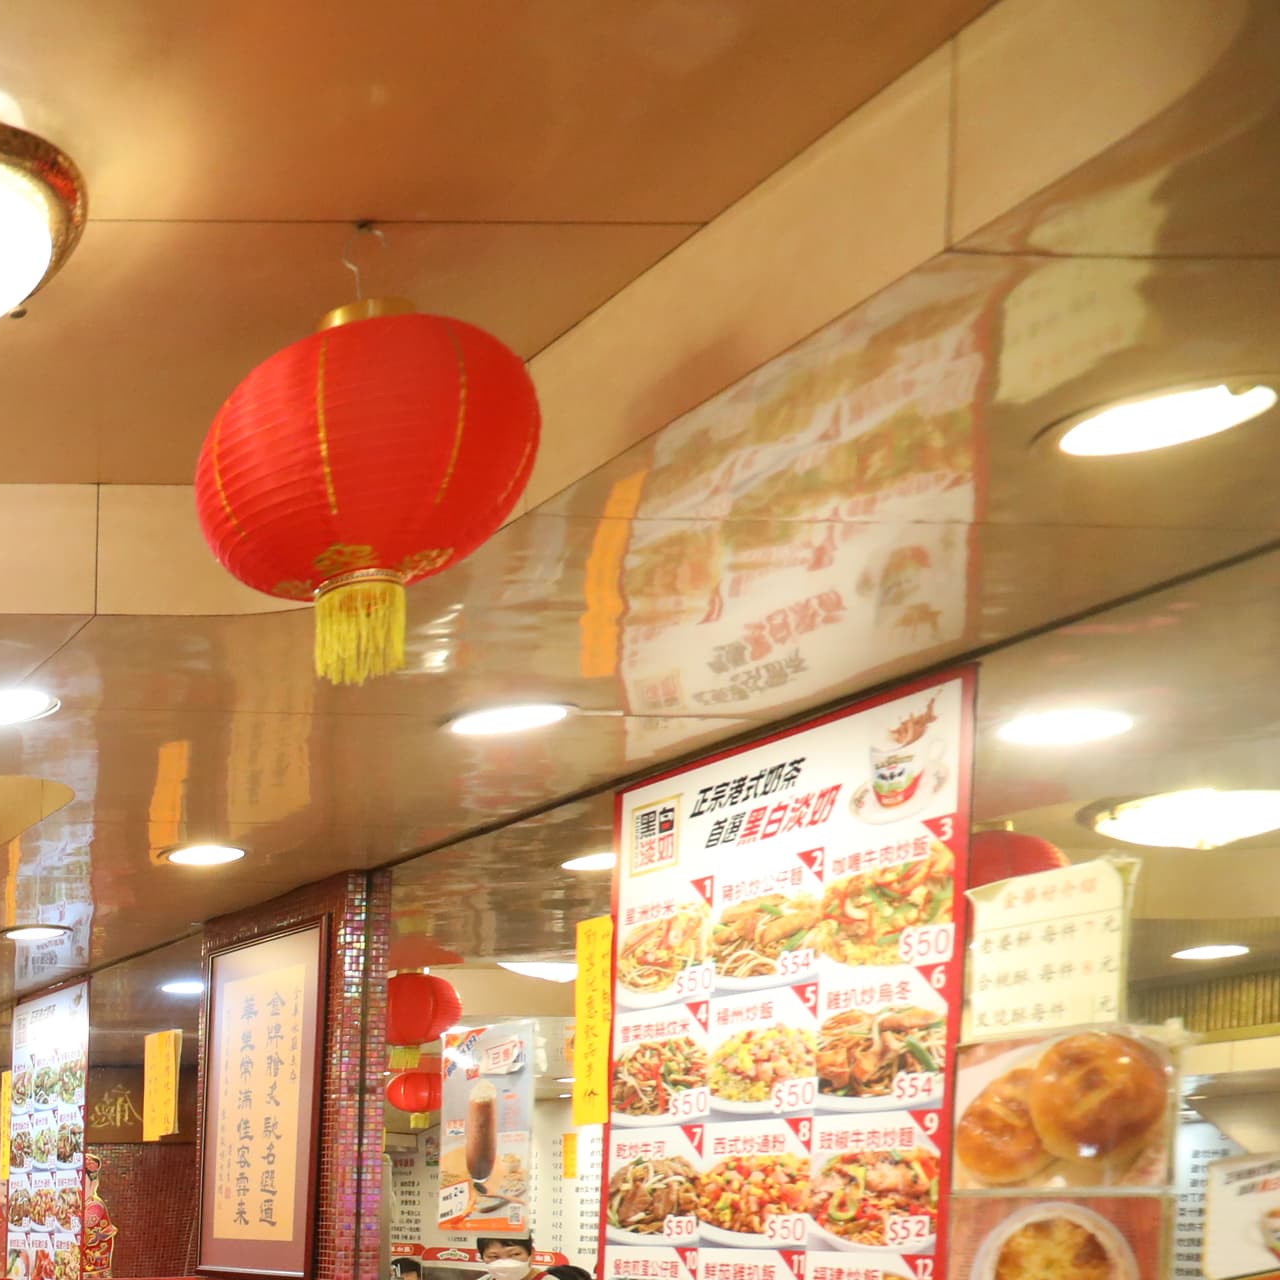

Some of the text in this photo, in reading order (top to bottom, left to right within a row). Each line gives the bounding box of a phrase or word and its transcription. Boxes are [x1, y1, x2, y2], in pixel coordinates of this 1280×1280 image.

[689, 757, 807, 819] 正宗港式奶茶
[705, 784, 842, 848] 首選黑白淡奶
[939, 818, 953, 841] 3
[810, 851, 823, 873] 2
[703, 879, 711, 897] 1
[900, 927, 951, 956] $50
[780, 953, 812, 976] $54
[676, 969, 714, 995] $50
[931, 969, 945, 989] 6
[804, 988, 816, 1007] 5
[696, 1005, 707, 1023] 4
[773, 1081, 815, 1109] $50
[894, 1076, 934, 1099] $54
[669, 1092, 708, 1116] $50
[798, 1121, 810, 1141] 8
[924, 1113, 938, 1134] 9
[692, 1128, 702, 1149] 7
[713, 1136, 786, 1155] 西式炒通粉
[664, 1218, 695, 1237] $50
[767, 1218, 806, 1241] $50
[889, 1218, 927, 1244] $52
[685, 1250, 697, 1271] 10
[791, 1253, 806, 1275] 11
[916, 1259, 933, 1280] 12
